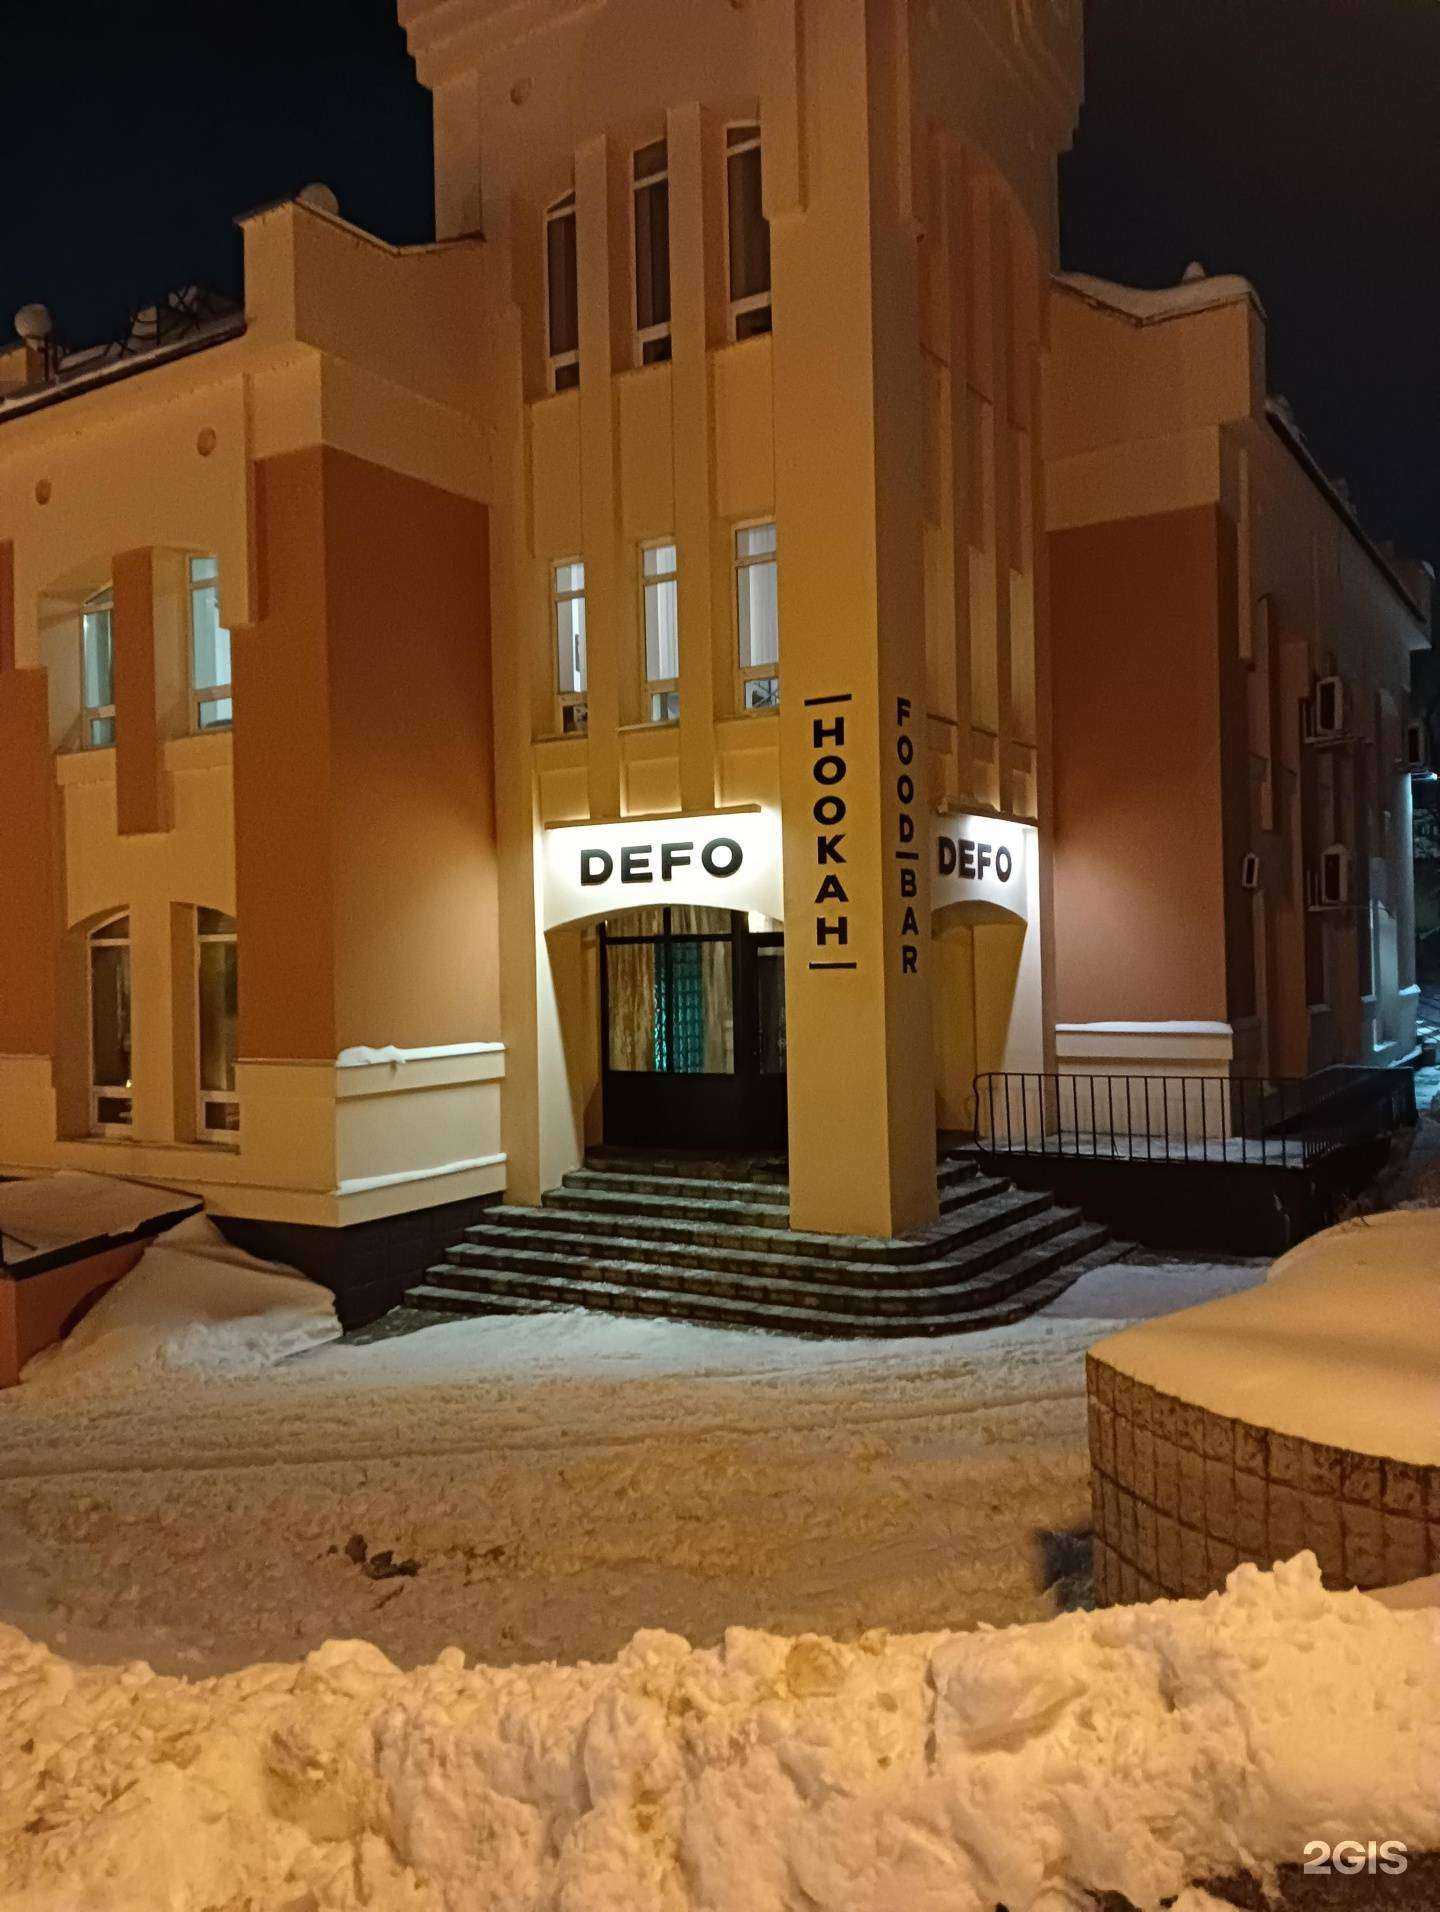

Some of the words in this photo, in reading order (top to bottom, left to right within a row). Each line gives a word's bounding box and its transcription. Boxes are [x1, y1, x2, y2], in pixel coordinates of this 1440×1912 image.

[897, 697, 915, 843] FOOD
[580, 837, 743, 886] DEFO
[813, 716, 848, 946] HOOKAH
[938, 836, 1012, 883] DEFO
[900, 868, 919, 974] BAR
